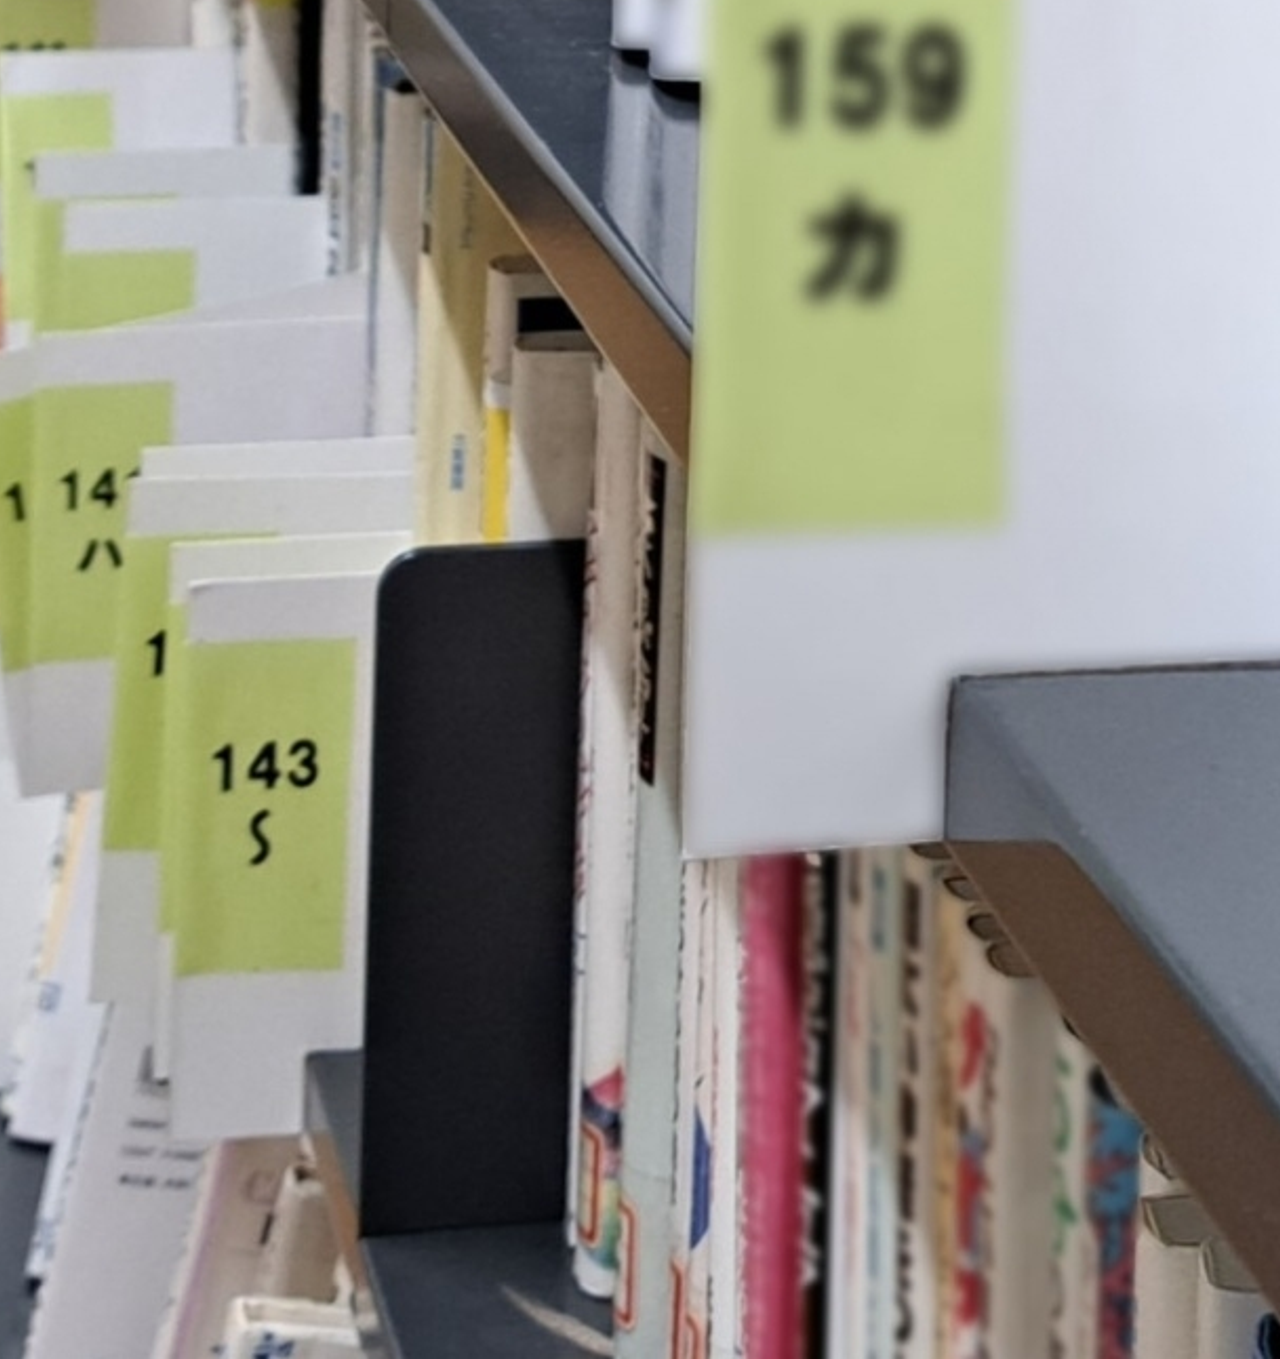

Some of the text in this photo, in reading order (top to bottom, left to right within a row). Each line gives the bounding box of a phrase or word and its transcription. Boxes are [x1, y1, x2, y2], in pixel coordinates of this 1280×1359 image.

[764, 21, 967, 131] 159
[59, 466, 141, 511] 14
[211, 737, 319, 793] 143
